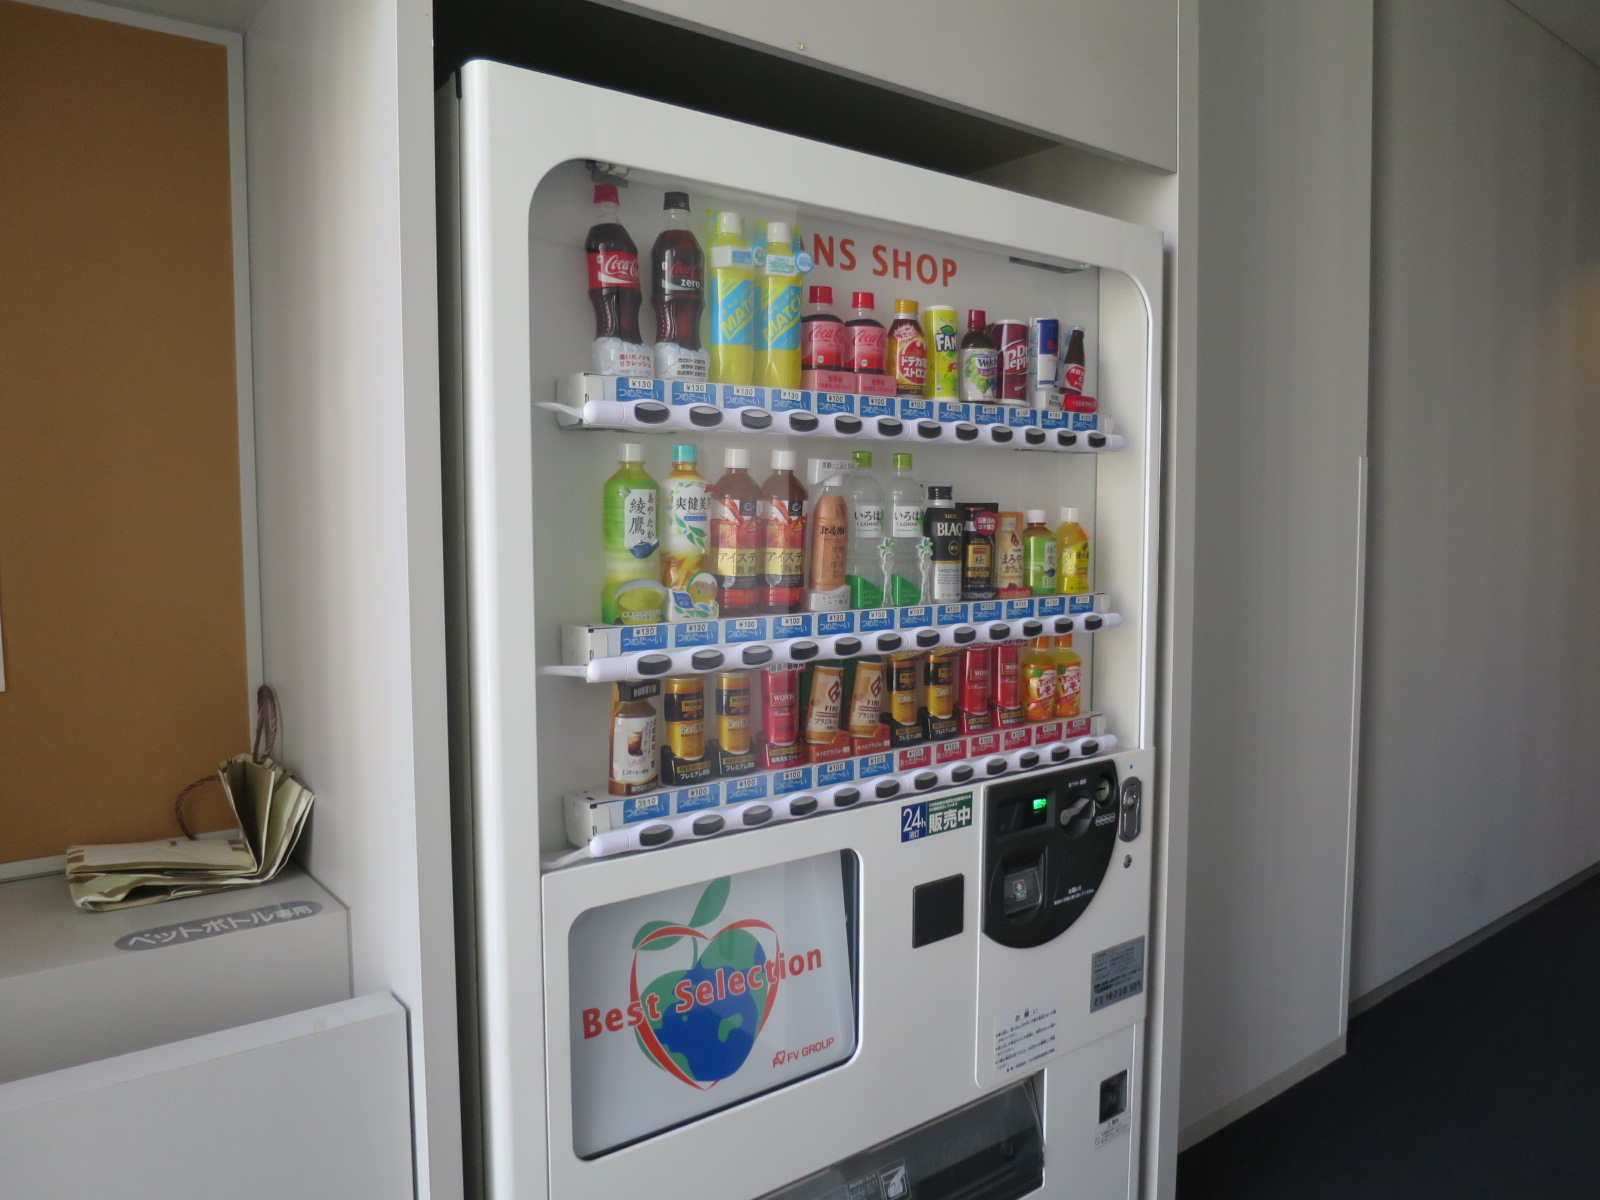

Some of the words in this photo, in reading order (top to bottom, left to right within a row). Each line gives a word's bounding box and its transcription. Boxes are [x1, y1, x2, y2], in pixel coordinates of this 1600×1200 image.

[872, 245, 957, 287] SHOP
[680, 278, 700, 289] zero
[631, 380, 652, 388] ¥130
[686, 384, 705, 392] ¥130
[735, 387, 753, 396] ¥130
[782, 391, 799, 400] ¥130
[828, 395, 844, 403] ¥100
[870, 398, 885, 406] ¥100
[910, 401, 925, 409] ¥100
[629, 497, 646, 536] 綾鷹
[646, 493, 655, 539] あやたか
[975, 555, 984, 564] 極
[785, 617, 801, 625] ¥100
[636, 628, 655, 636] ¥130
[688, 624, 706, 632] ¥130
[908, 749, 922, 757] ¥100
[870, 756, 884, 764] ¥100
[829, 763, 844, 771] ¥100
[785, 771, 801, 779] ¥100
[739, 778, 756, 787] ¥100
[690, 788, 707, 797] ¥100
[903, 806, 927, 832] 24h
[928, 806, 971, 834] 販売中
[128, 905, 312, 946] ペットボトル専用
[582, 993, 661, 1039] Best
[674, 948, 822, 1013] Selection
[787, 1050, 799, 1062] FV
[801, 1037, 835, 1057] GROUP
